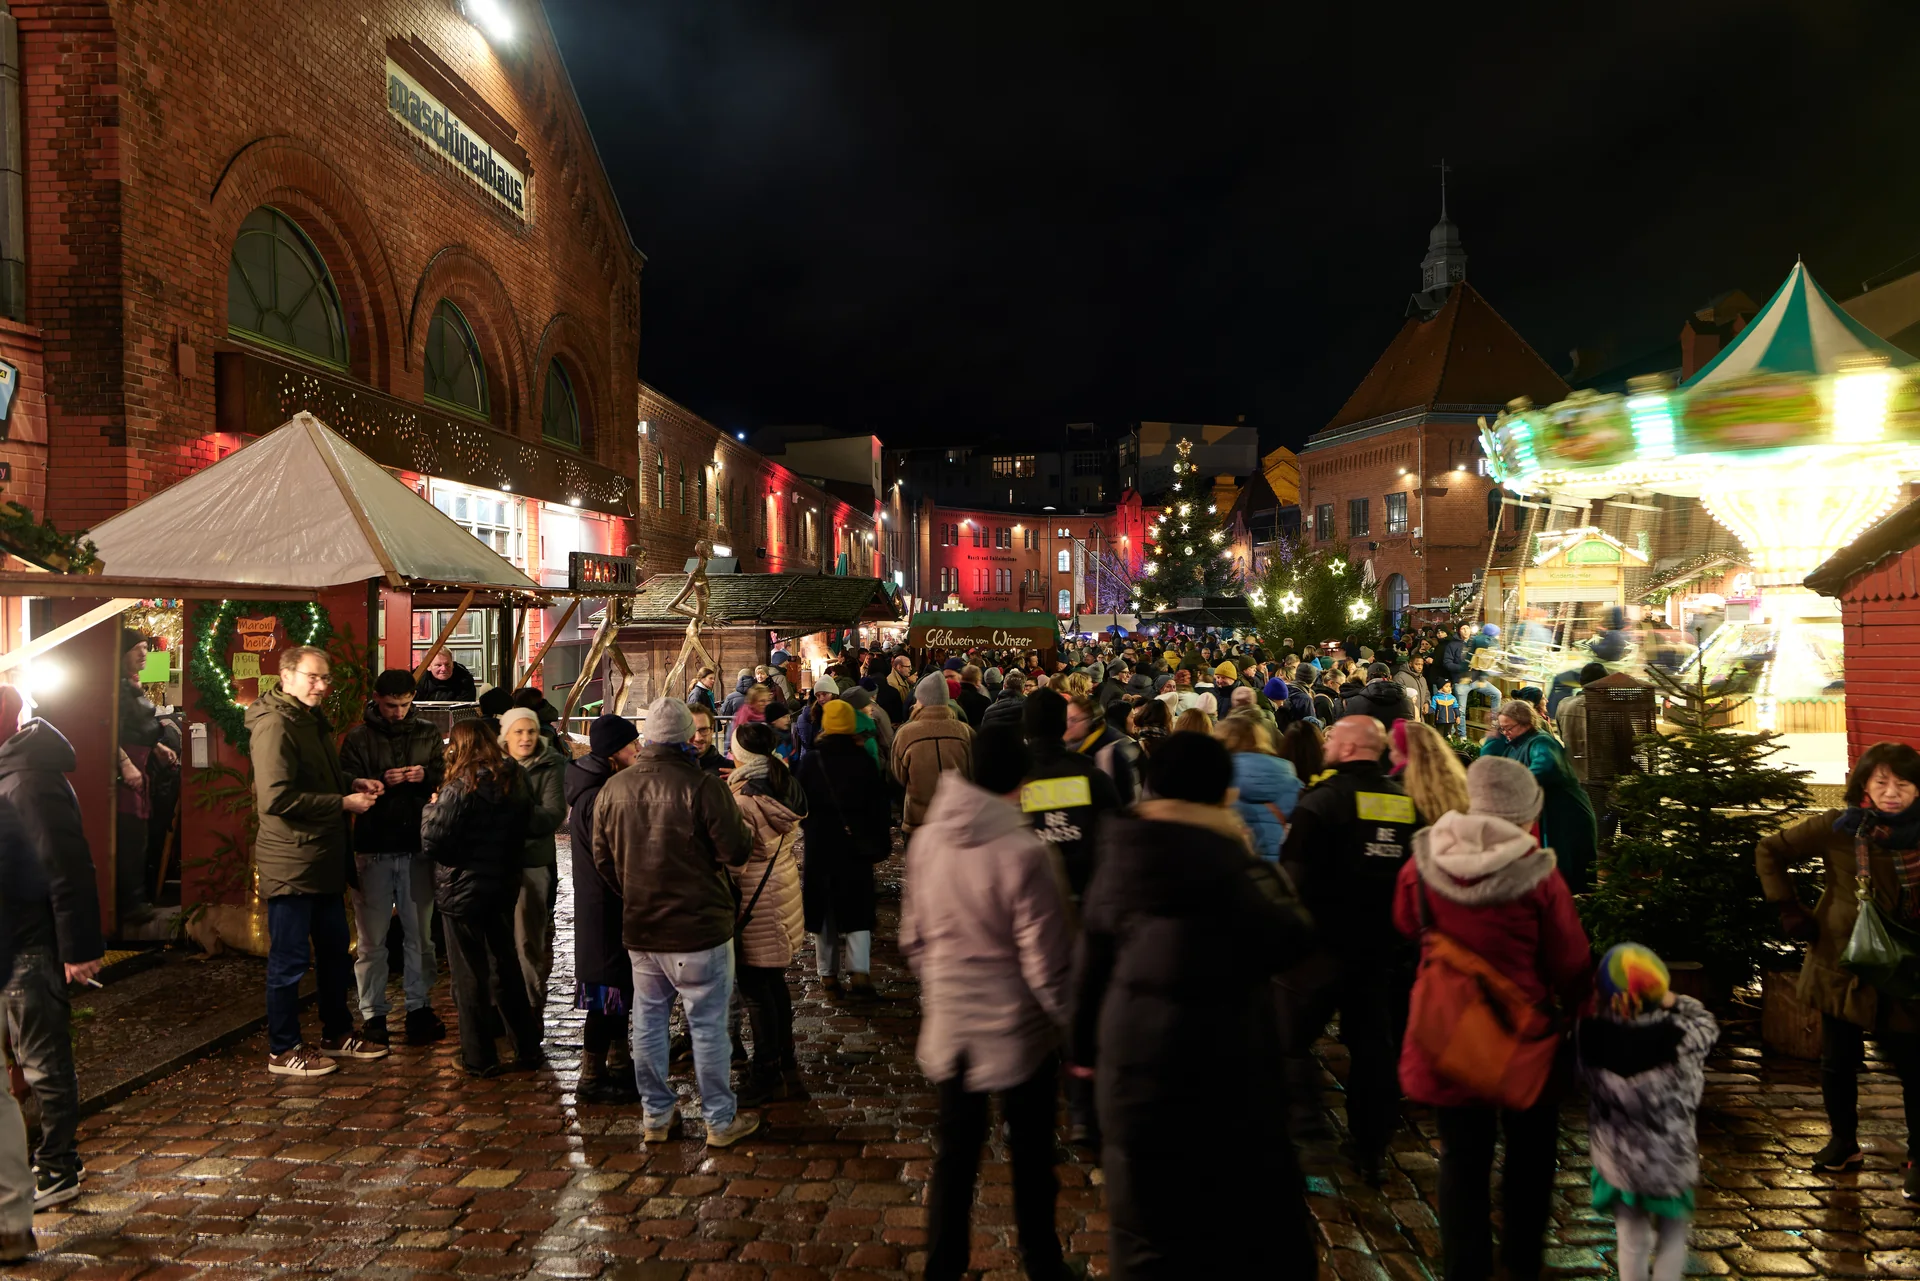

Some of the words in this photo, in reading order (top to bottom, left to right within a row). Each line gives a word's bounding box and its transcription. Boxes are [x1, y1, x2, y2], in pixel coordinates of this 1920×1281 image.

[583, 559, 631, 584] MARONI
[239, 621, 273, 630] Maroni
[925, 628, 974, 648] Glühwein
[992, 629, 1033, 647] Winzer
